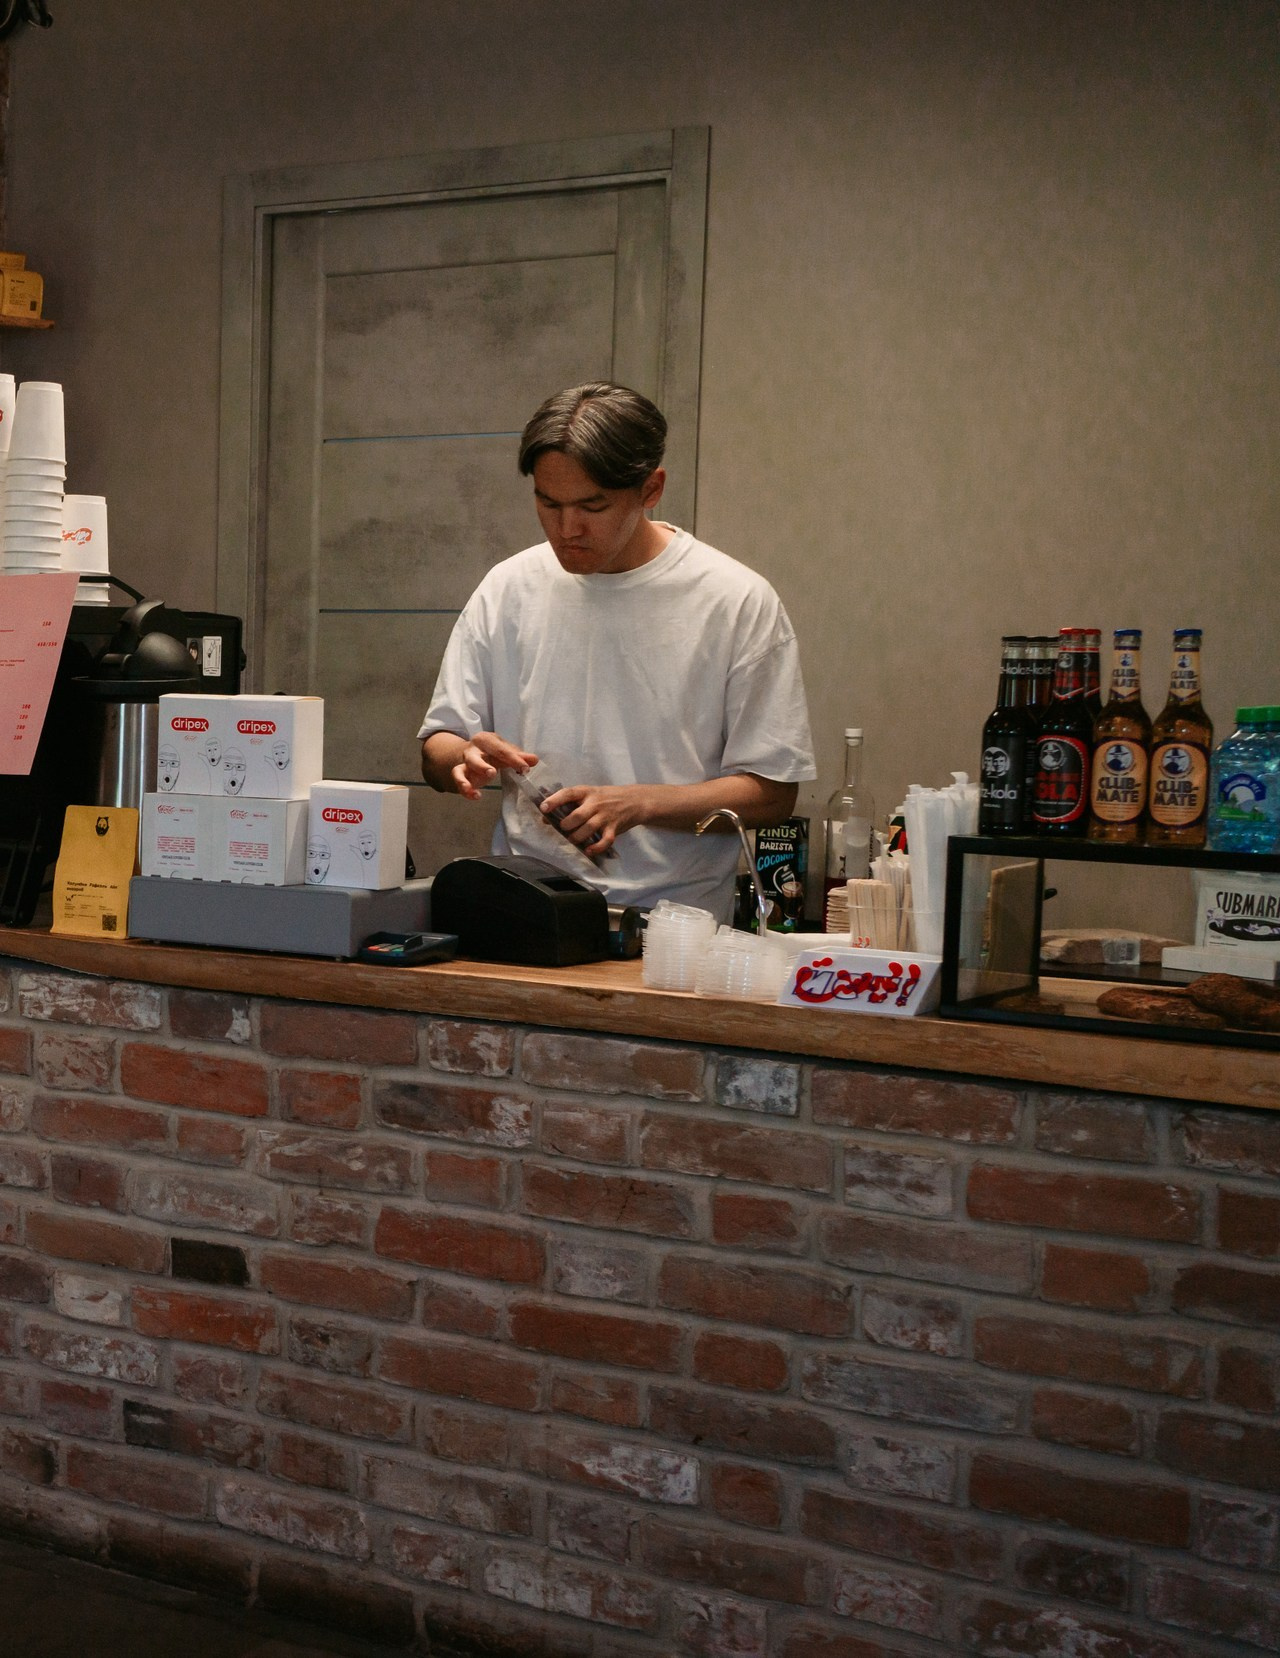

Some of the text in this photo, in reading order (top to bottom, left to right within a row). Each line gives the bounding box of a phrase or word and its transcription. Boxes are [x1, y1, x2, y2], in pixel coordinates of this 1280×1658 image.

[173, 718, 208, 731] dripex
[239, 721, 274, 734] dripex
[1098, 777, 1141, 790] CLUB-
[1156, 780, 1200, 794] CLUB-
[1096, 788, 1139, 803] MATE
[1153, 792, 1198, 807] MATE
[324, 809, 361, 823] dripex
[758, 828, 797, 839] ZINUS
[759, 841, 793, 852] BARISTA
[756, 853, 796, 872] COCONUT
